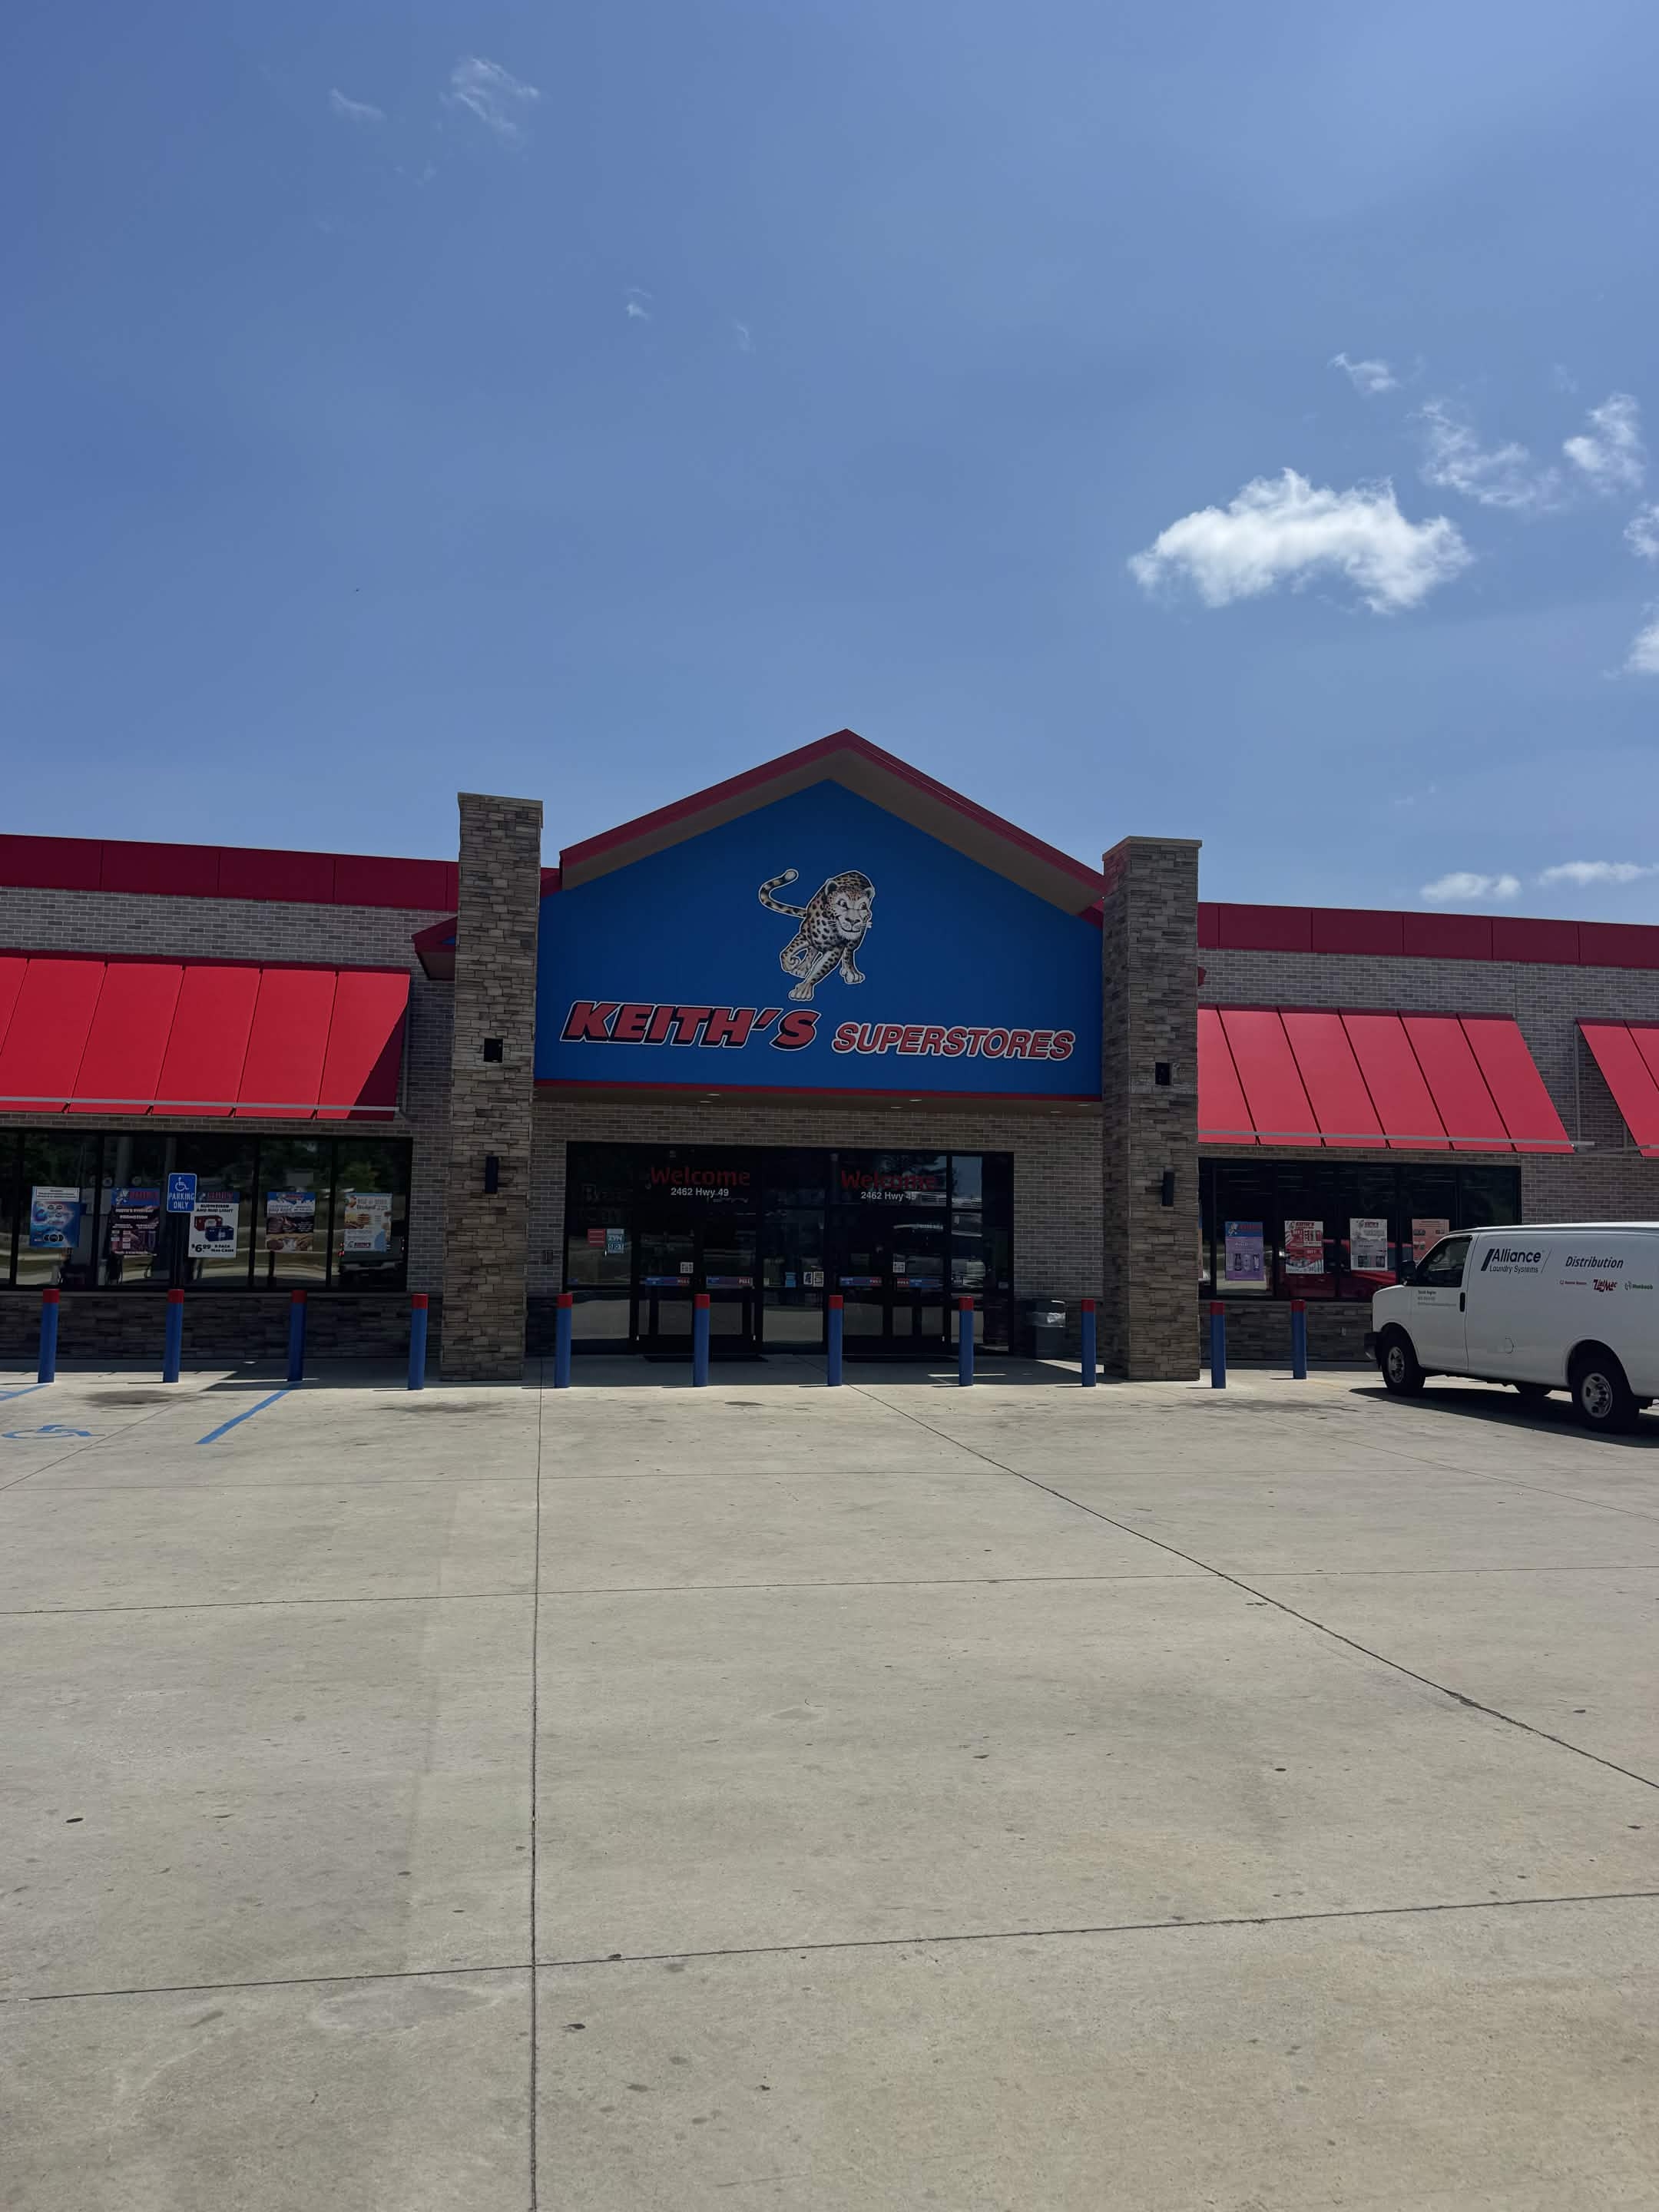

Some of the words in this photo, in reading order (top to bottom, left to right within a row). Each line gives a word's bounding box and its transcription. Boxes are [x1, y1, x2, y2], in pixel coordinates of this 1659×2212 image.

[561, 1000, 821, 1051] KEITH'S
[831, 1022, 1076, 1060] SUPERSTORES
[651, 1167, 750, 1186] Welcome
[841, 1168, 935, 1190] Welcome
[168, 1192, 194, 1200] PARKING
[671, 1187, 693, 1196] 2462
[696, 1187, 714, 1199] Hwy
[718, 1188, 729, 1197] 49
[860, 1191, 882, 1200] 2462
[884, 1192, 903, 1201] Hwy
[1492, 1249, 1541, 1263] Alliance
[1565, 1256, 1624, 1269] Distribution
[1489, 1265, 1513, 1274] Laundry
